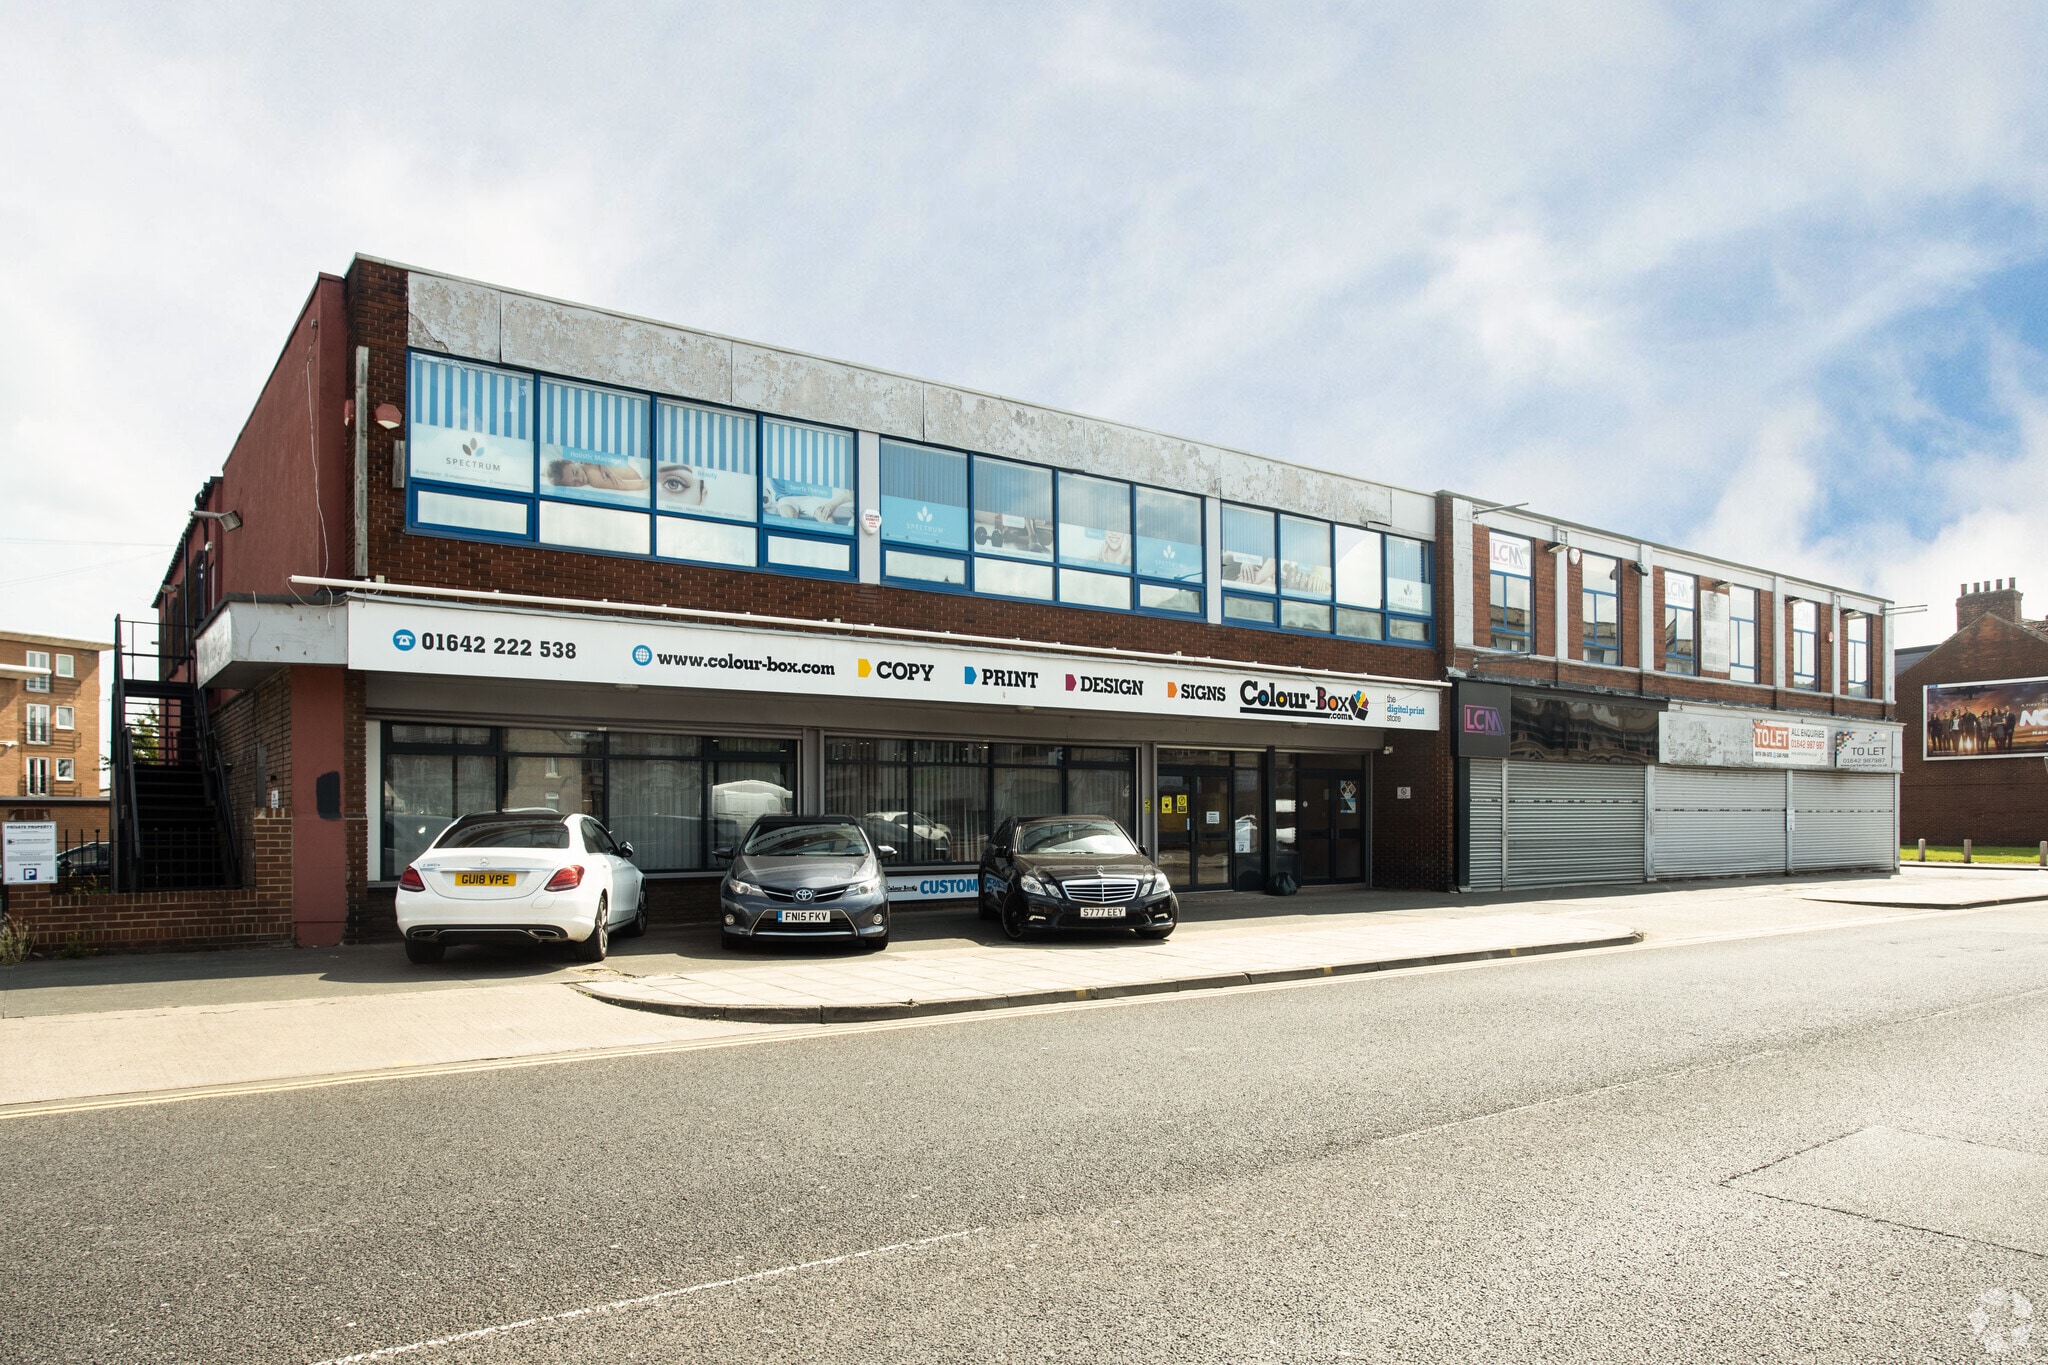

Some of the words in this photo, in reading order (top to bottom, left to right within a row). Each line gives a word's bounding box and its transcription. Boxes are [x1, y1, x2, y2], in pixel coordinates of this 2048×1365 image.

[446, 457, 501, 472] SPECTRUM
[905, 523, 944, 533] SPECTRUM
[1492, 542, 1523, 565] LCM
[421, 632, 486, 653] 01642
[493, 637, 532, 657] 222
[539, 640, 577, 659] 538
[657, 653, 835, 676] www.colour-box.com
[876, 660, 935, 682] COPY
[981, 668, 1039, 689] PRINT
[1080, 675, 1144, 696] DESIGN
[1180, 683, 1226, 702] SIGNS
[1239, 679, 1349, 712] Colour-Box
[1386, 694, 1397, 704] the
[1329, 712, 1348, 721] .com
[1386, 705, 1409, 715] digital
[1409, 707, 1425, 716] print
[1386, 714, 1402, 722] store
[1466, 708, 1502, 731] LCM
[1755, 728, 1769, 746] TO
[1770, 729, 1788, 747] LET
[1791, 728, 1800, 737] ALL
[1801, 729, 1825, 739] ENQUIRIES
[1791, 739, 1806, 749] 01642
[1851, 747, 1865, 756] TO
[1867, 746, 1886, 756] LET
[25, 869, 36, 880] P
[461, 874, 486, 885] GU18
[489, 874, 510, 885] VPE
[920, 878, 978, 895] CUSTOM
[785, 912, 806, 921] FN15
[809, 912, 827, 921] FKV
[1083, 908, 1105, 917] S777
[1107, 908, 1123, 917] EEY
